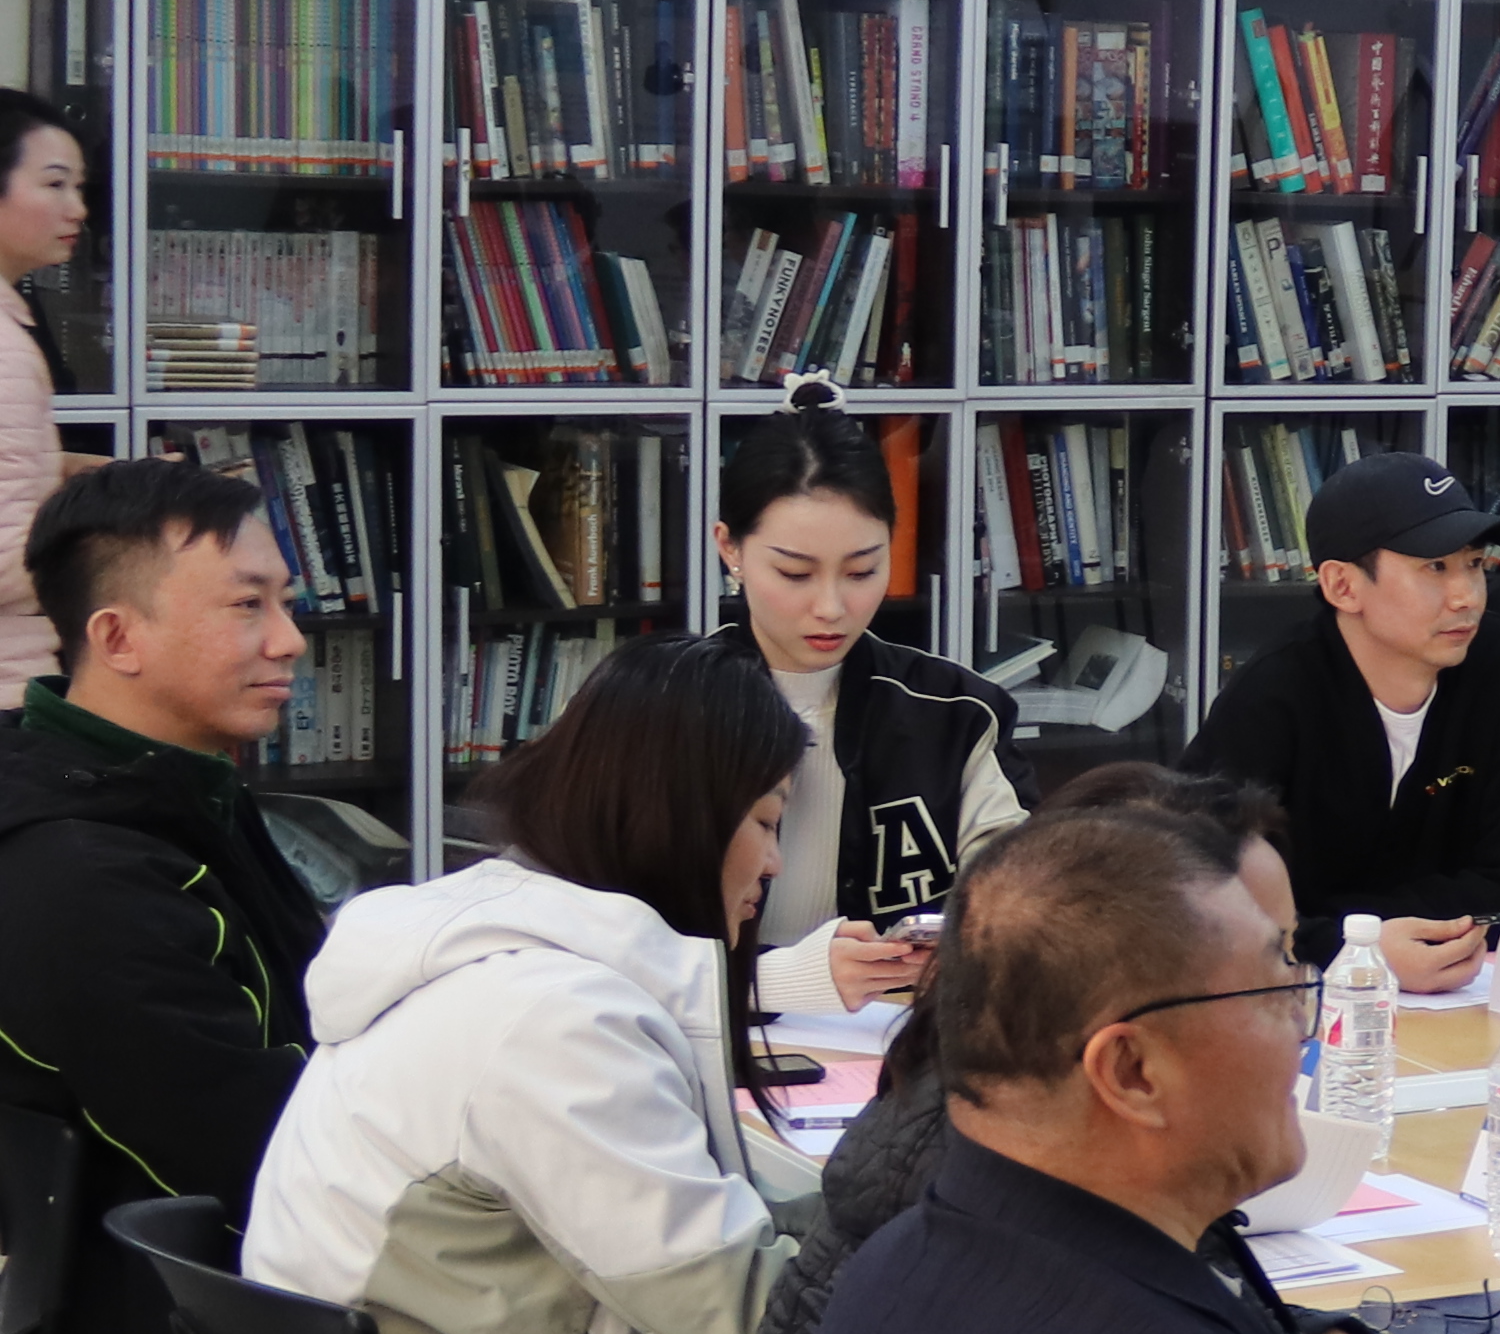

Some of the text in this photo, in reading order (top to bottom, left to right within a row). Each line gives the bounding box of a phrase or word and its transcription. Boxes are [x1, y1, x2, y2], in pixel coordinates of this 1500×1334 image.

[756, 258, 797, 354] FUNKYNOTES
[1141, 227, 1154, 333] John Singer Sargent
[586, 513, 599, 597] Frank Auerbach
[869, 795, 958, 915] A
